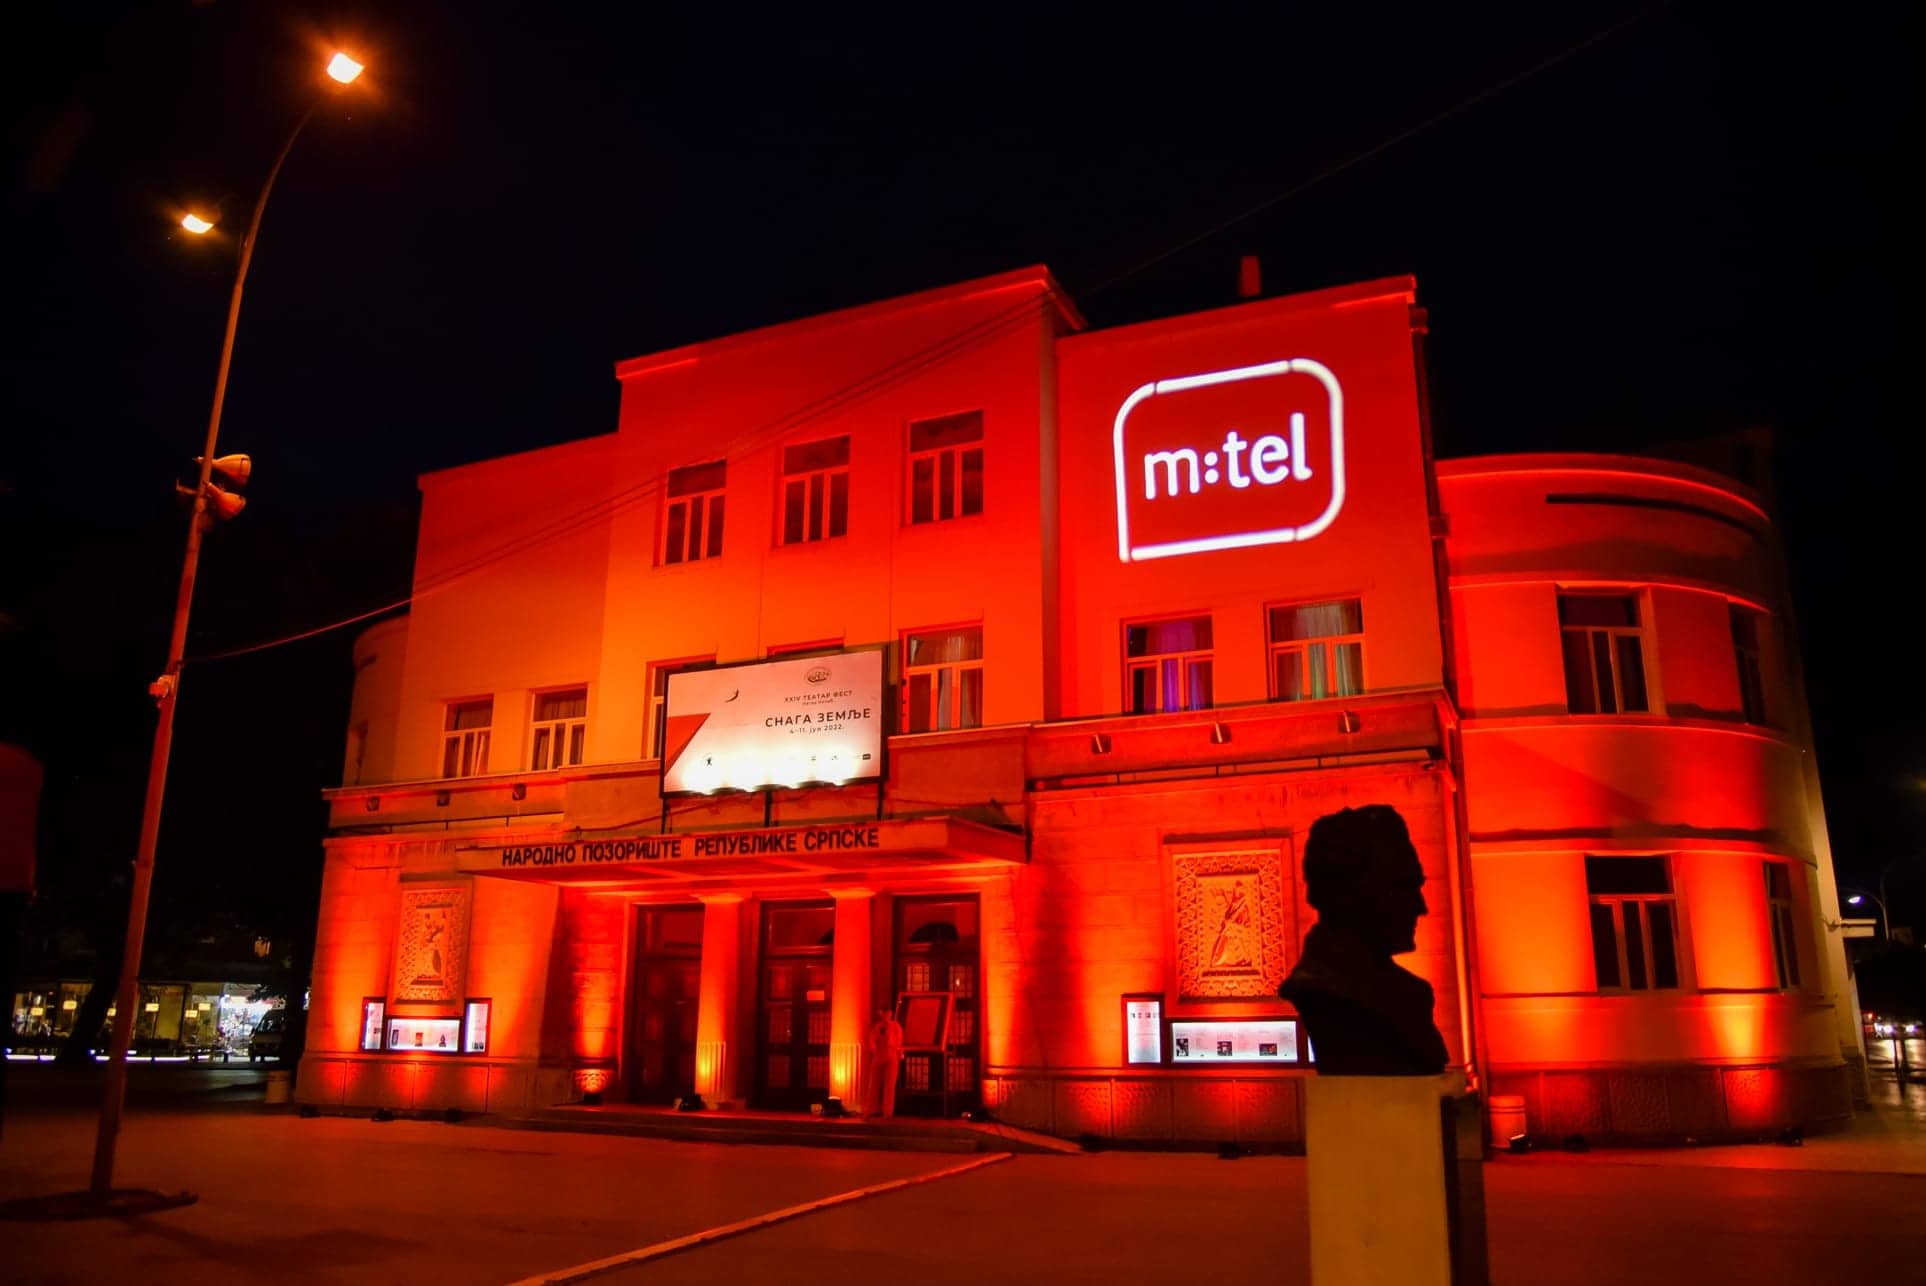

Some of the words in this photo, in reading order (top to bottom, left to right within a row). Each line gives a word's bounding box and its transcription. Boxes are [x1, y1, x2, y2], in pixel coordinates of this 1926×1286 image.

[1144, 412, 1313, 500] m:tel
[803, 692, 831, 701] ТЕАТАР
[833, 690, 853, 698] ФЕСТ
[765, 714, 812, 727] СНАГА
[817, 708, 871, 723] ЗЕМЉЕ
[502, 845, 576, 866] НАРОДНО
[582, 840, 681, 862] ПОЗОРИШТЕ
[694, 833, 797, 856] РЕПУБЛИКЕ
[804, 828, 880, 850] СРПСКЕ
